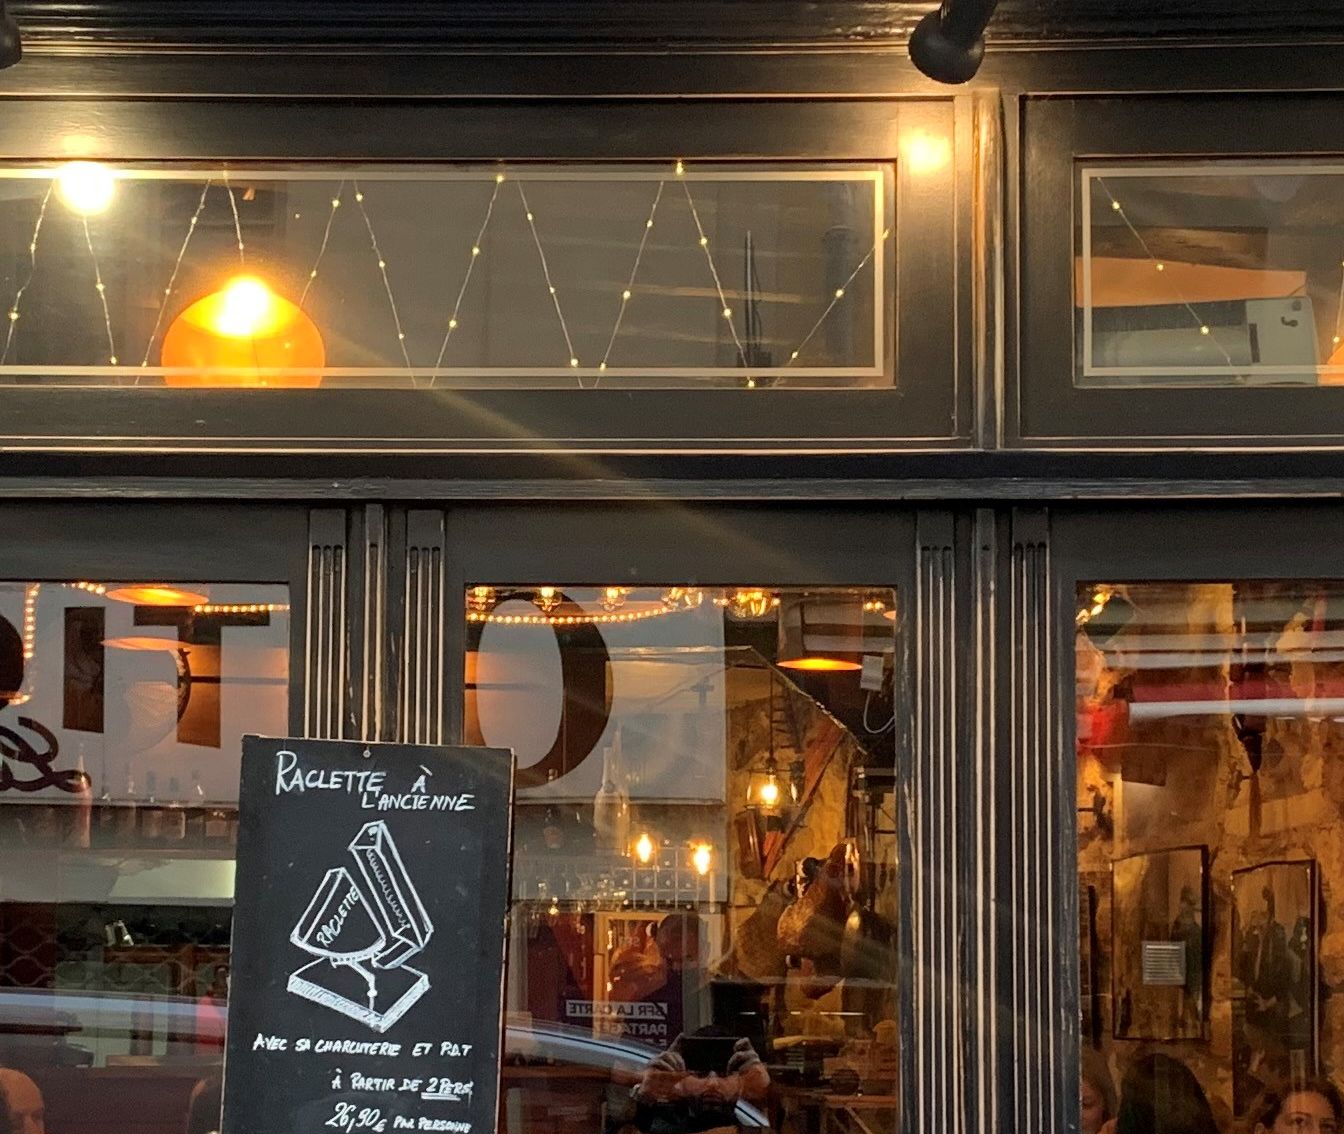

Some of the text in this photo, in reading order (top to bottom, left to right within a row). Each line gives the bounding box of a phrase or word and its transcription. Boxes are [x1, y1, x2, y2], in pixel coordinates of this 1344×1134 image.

[275, 751, 386, 794] RACLETTE
[316, 887, 358, 947] RACLETTE
[253, 1033, 287, 1052] AVEC
[296, 1039, 311, 1052] SA
[315, 1039, 400, 1056] CHARCUTERIE
[412, 1043, 431, 1056] ET
[350, 1072, 395, 1091] PARTIR
[399, 1077, 422, 1092] DE
